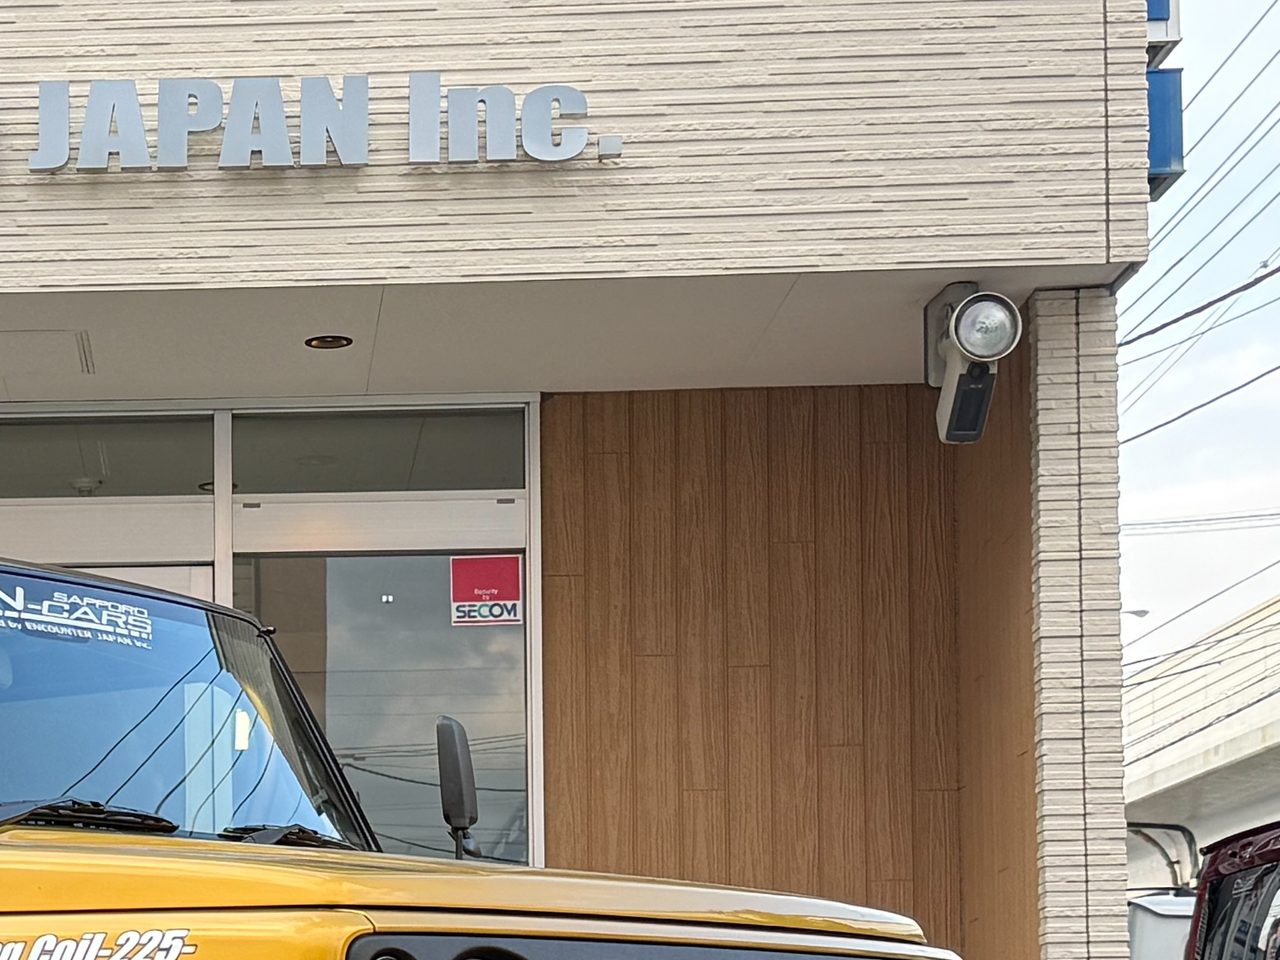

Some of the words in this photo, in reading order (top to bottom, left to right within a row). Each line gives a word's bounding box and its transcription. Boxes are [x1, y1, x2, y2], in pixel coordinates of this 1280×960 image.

[29, 74, 369, 171] JAPAN
[408, 71, 621, 163] Inc.
[53, 592, 148, 617] SAPPORO
[456, 603, 517, 619] SECOM
[8, 618, 22, 630] by
[25, 621, 93, 639] ENCOUNTER
[97, 631, 132, 647] JAPAN
